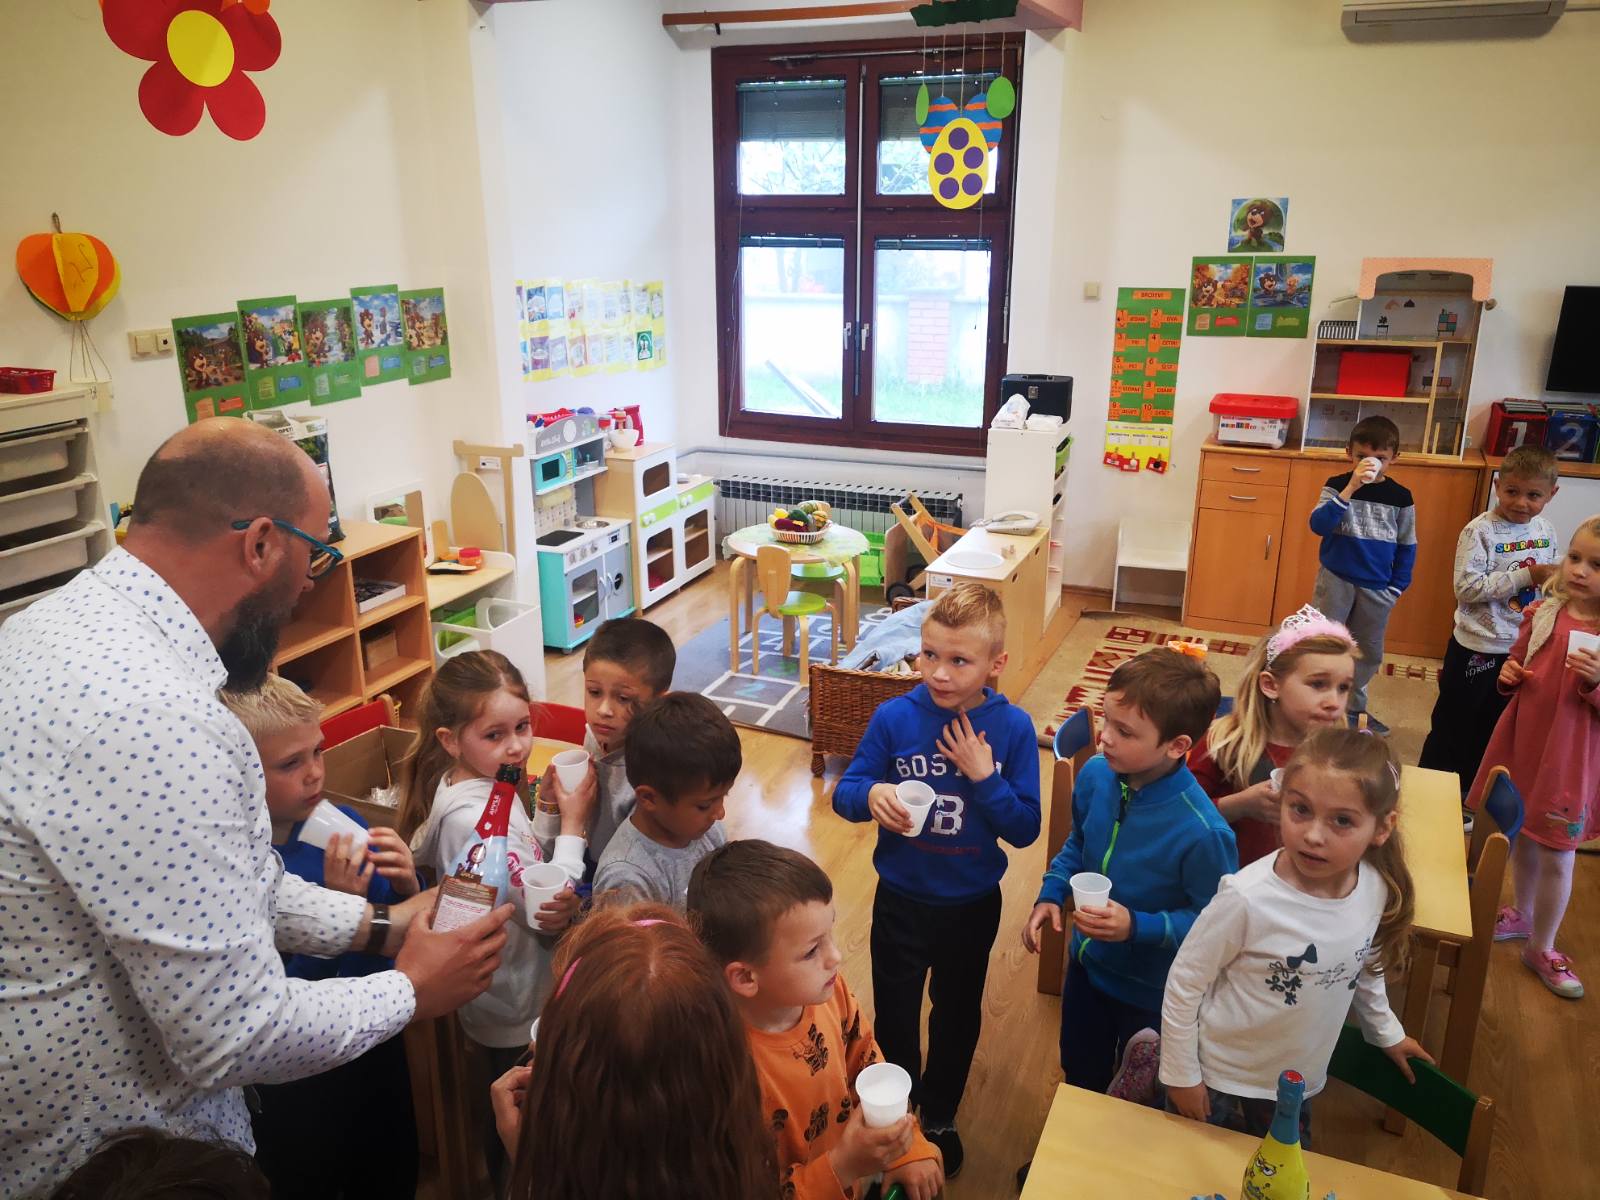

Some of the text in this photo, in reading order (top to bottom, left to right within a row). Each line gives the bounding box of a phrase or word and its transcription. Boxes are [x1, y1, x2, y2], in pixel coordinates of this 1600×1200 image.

[1508, 421, 1527, 453] 1
[1555, 422, 1584, 459] 2
[1495, 540, 1526, 553] SUPER
[930, 793, 965, 835] B
